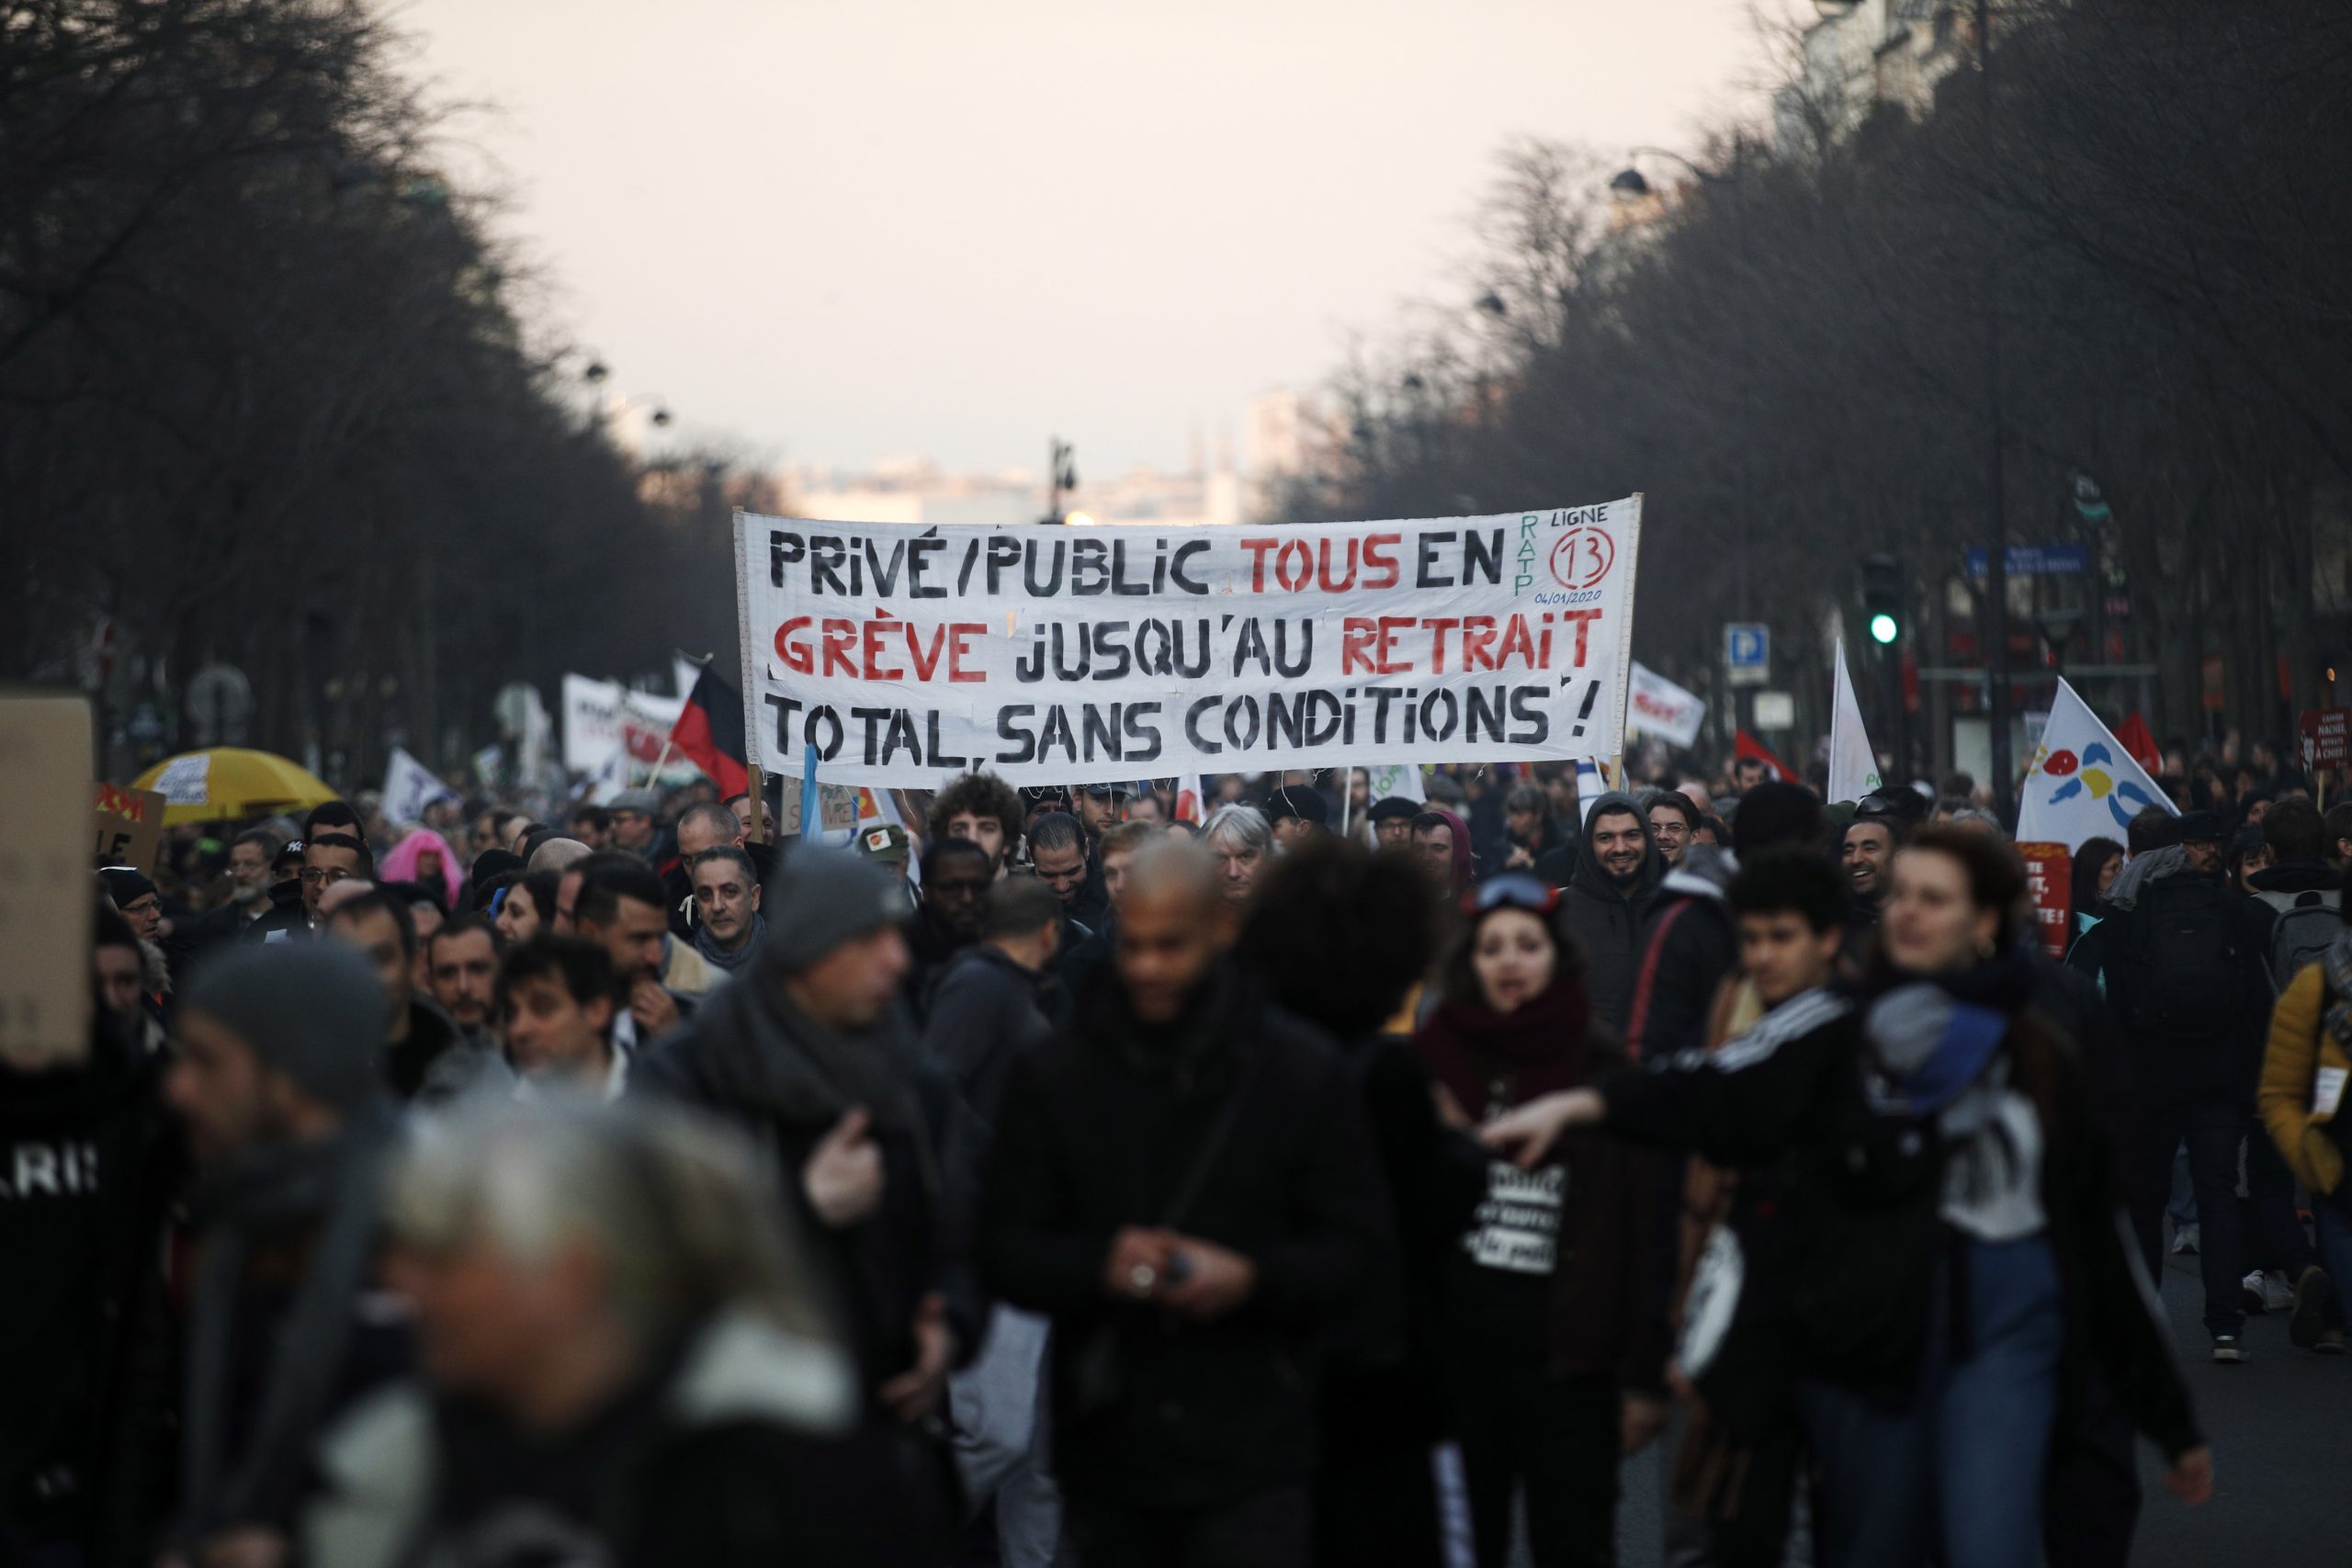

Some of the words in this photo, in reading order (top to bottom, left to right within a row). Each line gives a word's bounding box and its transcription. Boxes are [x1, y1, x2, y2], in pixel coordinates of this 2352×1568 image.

[1240, 534, 1401, 593] TOUS
[1417, 528, 1505, 589] EN
[1514, 515, 1539, 597] RATP
[1560, 536, 1604, 581] 13
[774, 606, 988, 682] GRÈVE
[764, 692, 984, 773] TOTAL,
[995, 702, 1162, 764] SANS
